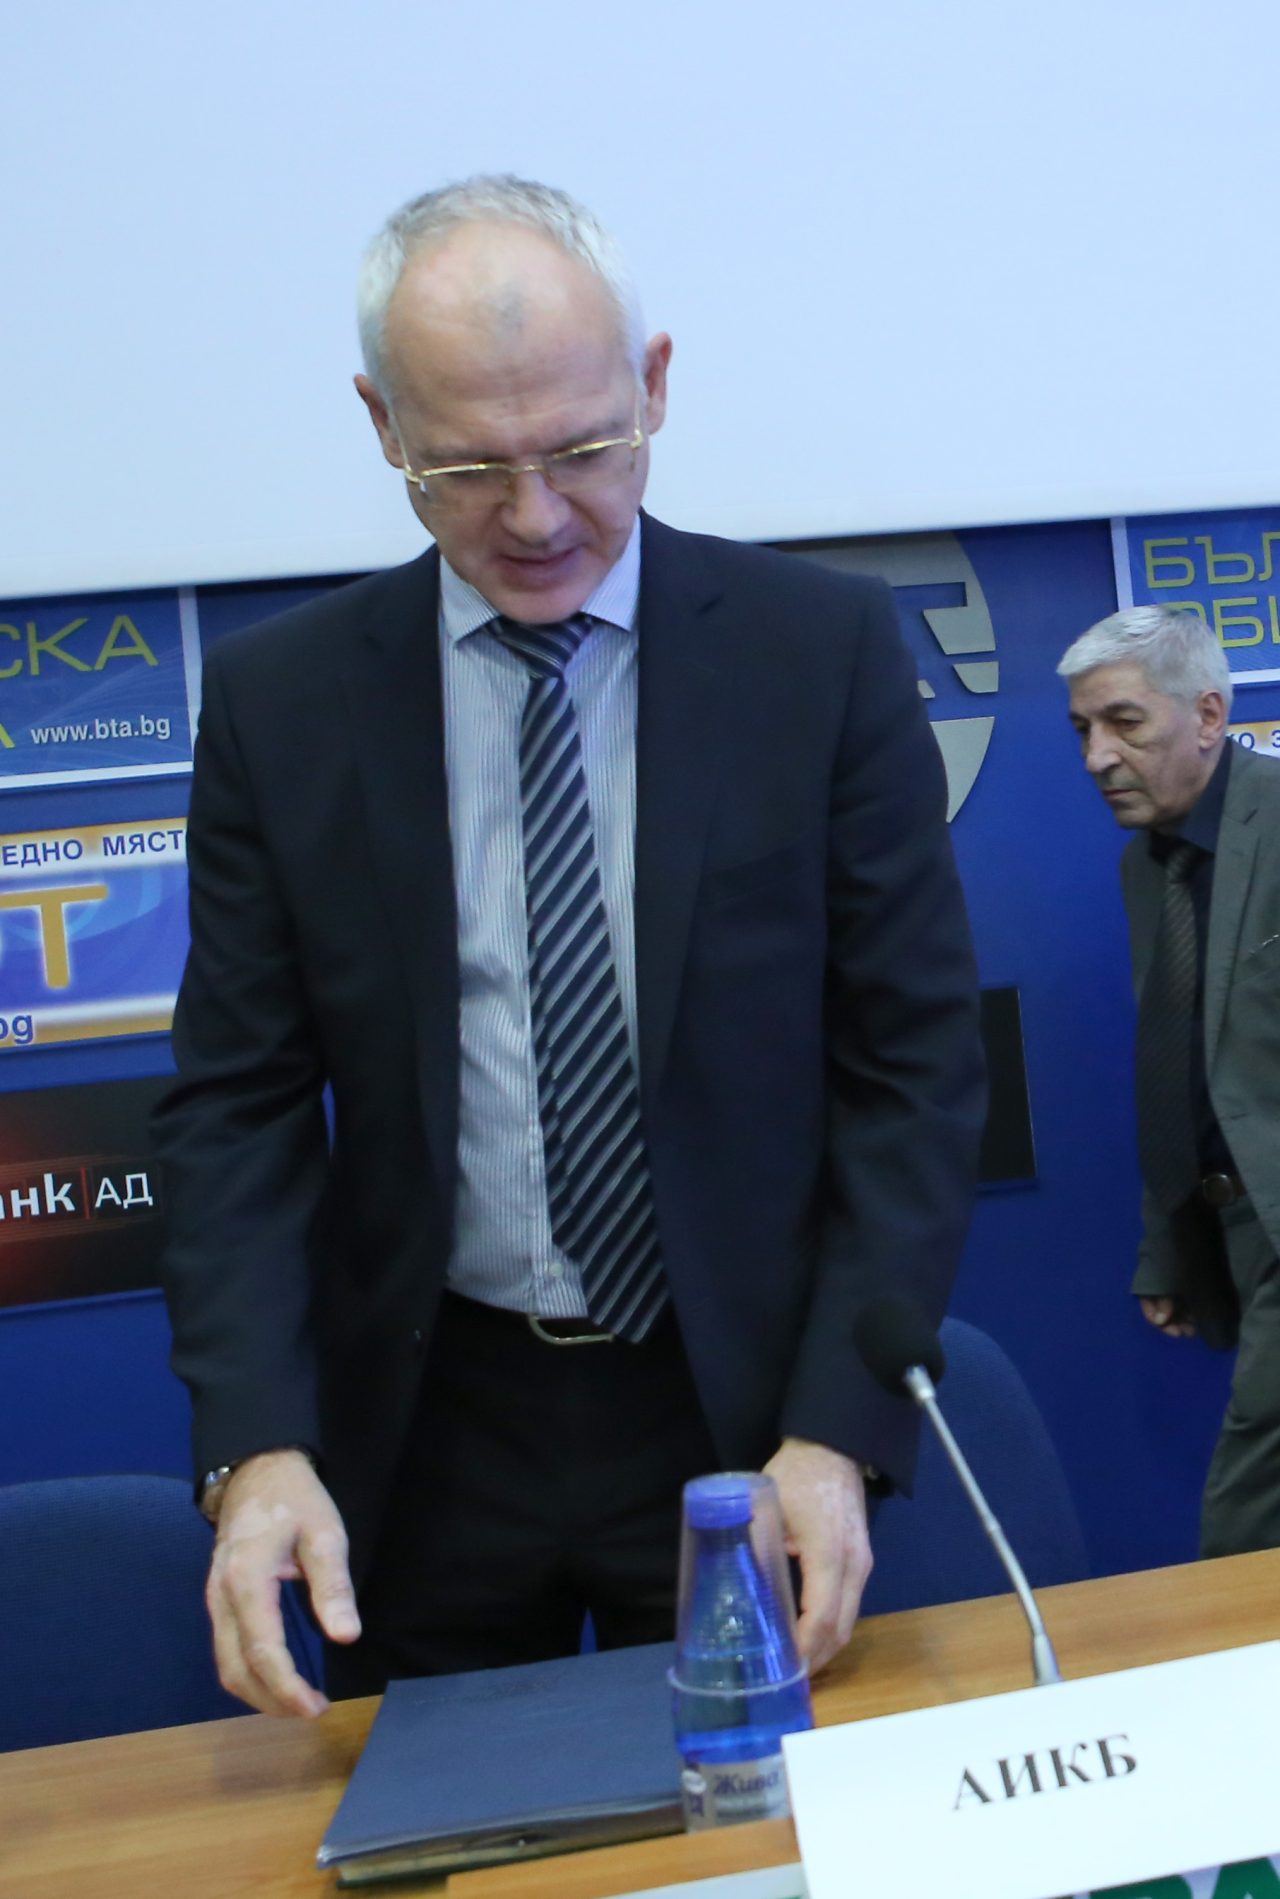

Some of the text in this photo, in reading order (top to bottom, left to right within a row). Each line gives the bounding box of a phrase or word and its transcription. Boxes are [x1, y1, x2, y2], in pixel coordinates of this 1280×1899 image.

[30, 714, 171, 745] www.bta.bg
[2, 839, 83, 868] ЕДНО
[95, 1172, 153, 1209] АД
[951, 1733, 1139, 1812] АИКБ
